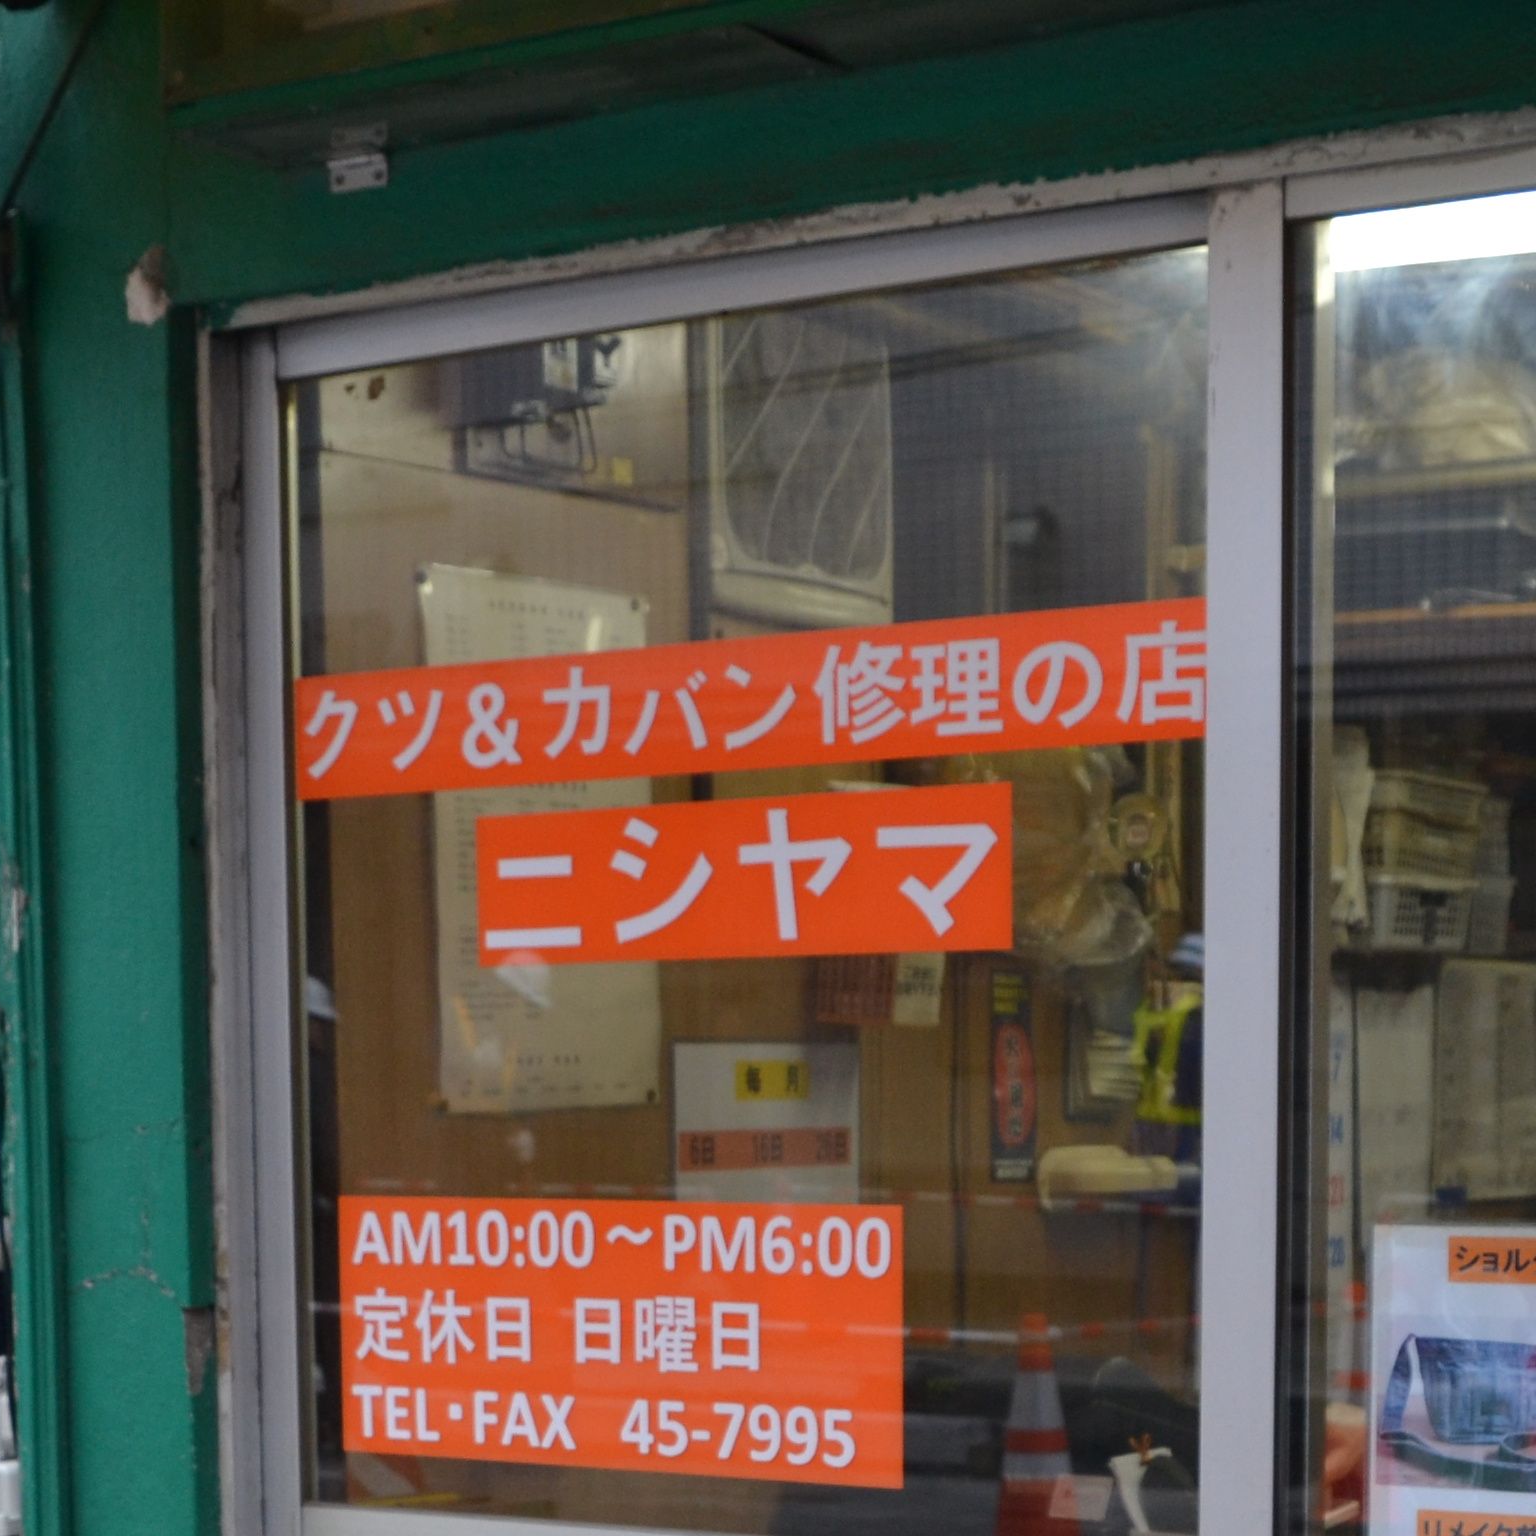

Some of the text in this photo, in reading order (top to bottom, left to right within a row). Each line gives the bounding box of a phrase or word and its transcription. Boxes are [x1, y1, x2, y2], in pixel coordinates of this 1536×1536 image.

[304, 620, 1205, 781] クツ&カバン修理の店
[484, 808, 998, 949] ニシヤマ
[354, 1287, 760, 1373] 定休日 日曜日
[619, 1398, 856, 1468] 45-7995
